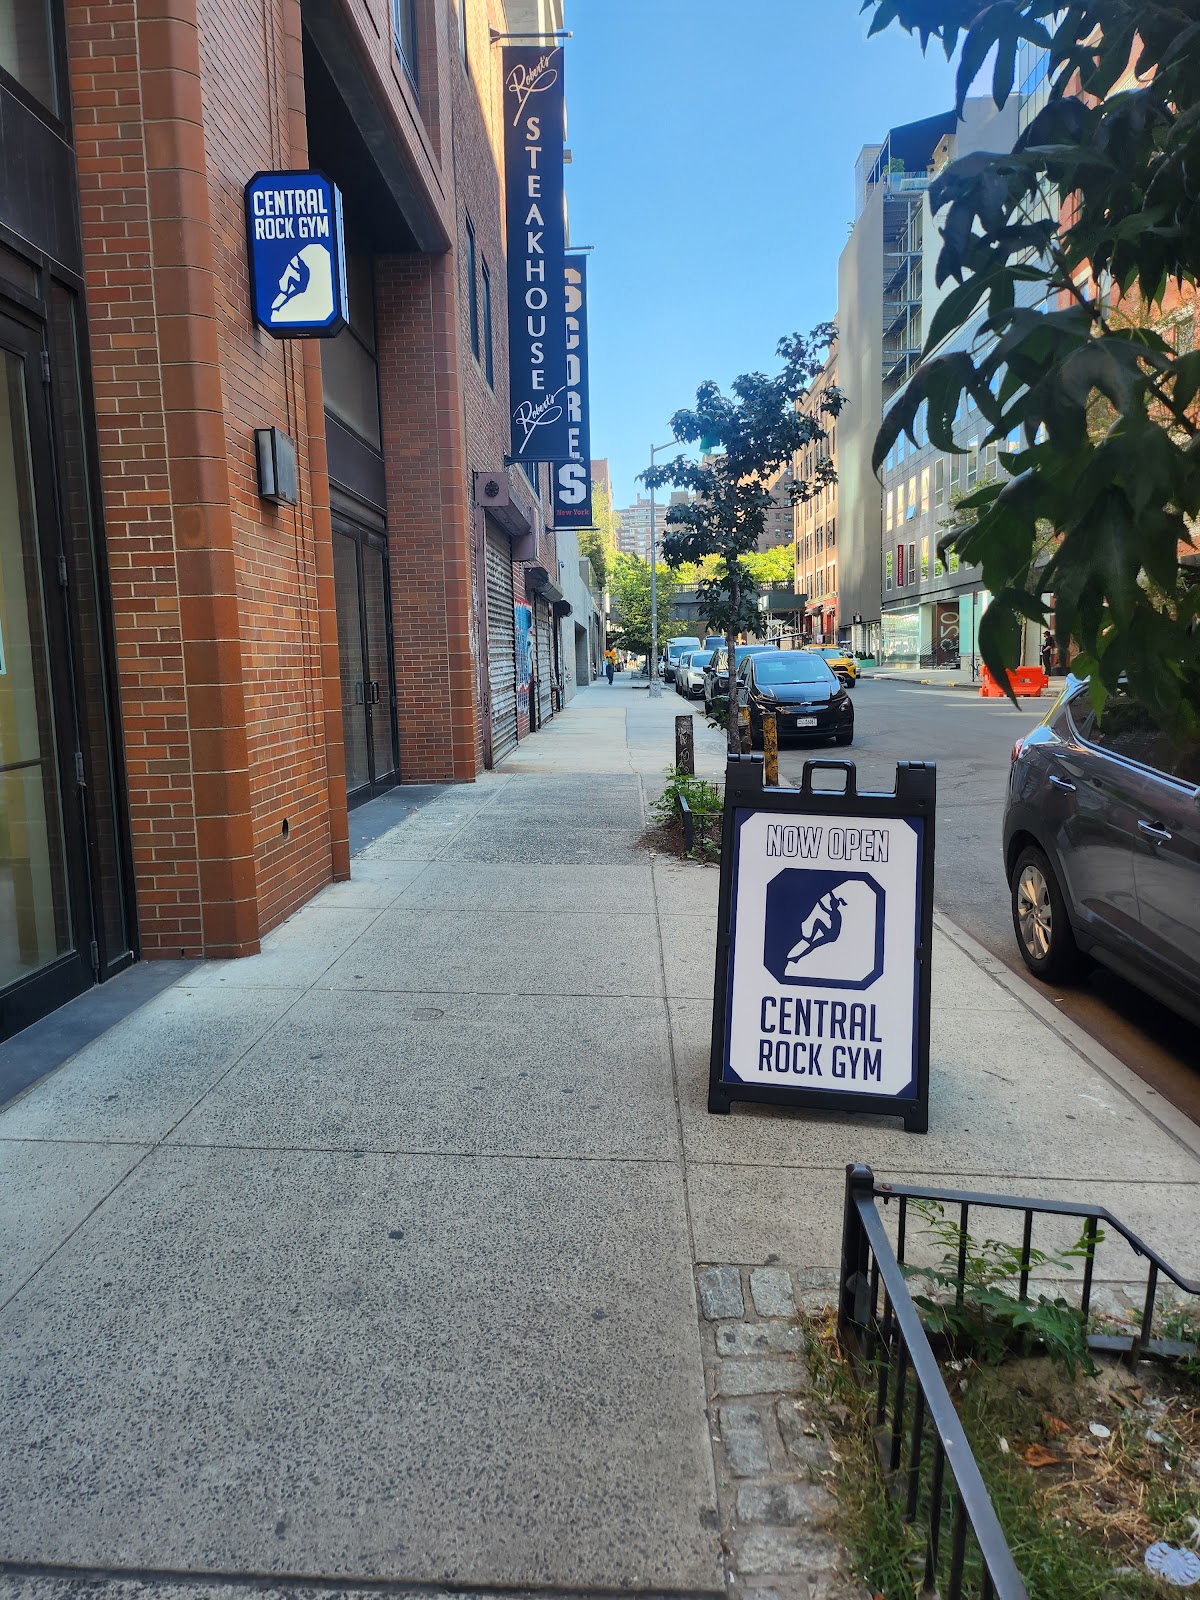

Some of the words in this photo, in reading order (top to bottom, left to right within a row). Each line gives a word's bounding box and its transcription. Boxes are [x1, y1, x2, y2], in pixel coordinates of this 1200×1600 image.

[505, 47, 560, 127] Robert's
[253, 188, 328, 216] CENTRAL
[254, 217, 296, 240] ROCK
[298, 215, 329, 239] GYM
[525, 117, 548, 390] STEAKHOUSE
[513, 386, 566, 454] Robert's
[573, 508, 590, 516] York
[766, 824, 822, 859] NOW
[827, 828, 890, 863] OPEN
[760, 996, 882, 1043] CENTRAL
[758, 1039, 823, 1076] ROCK
[831, 1045, 882, 1082] GYM
